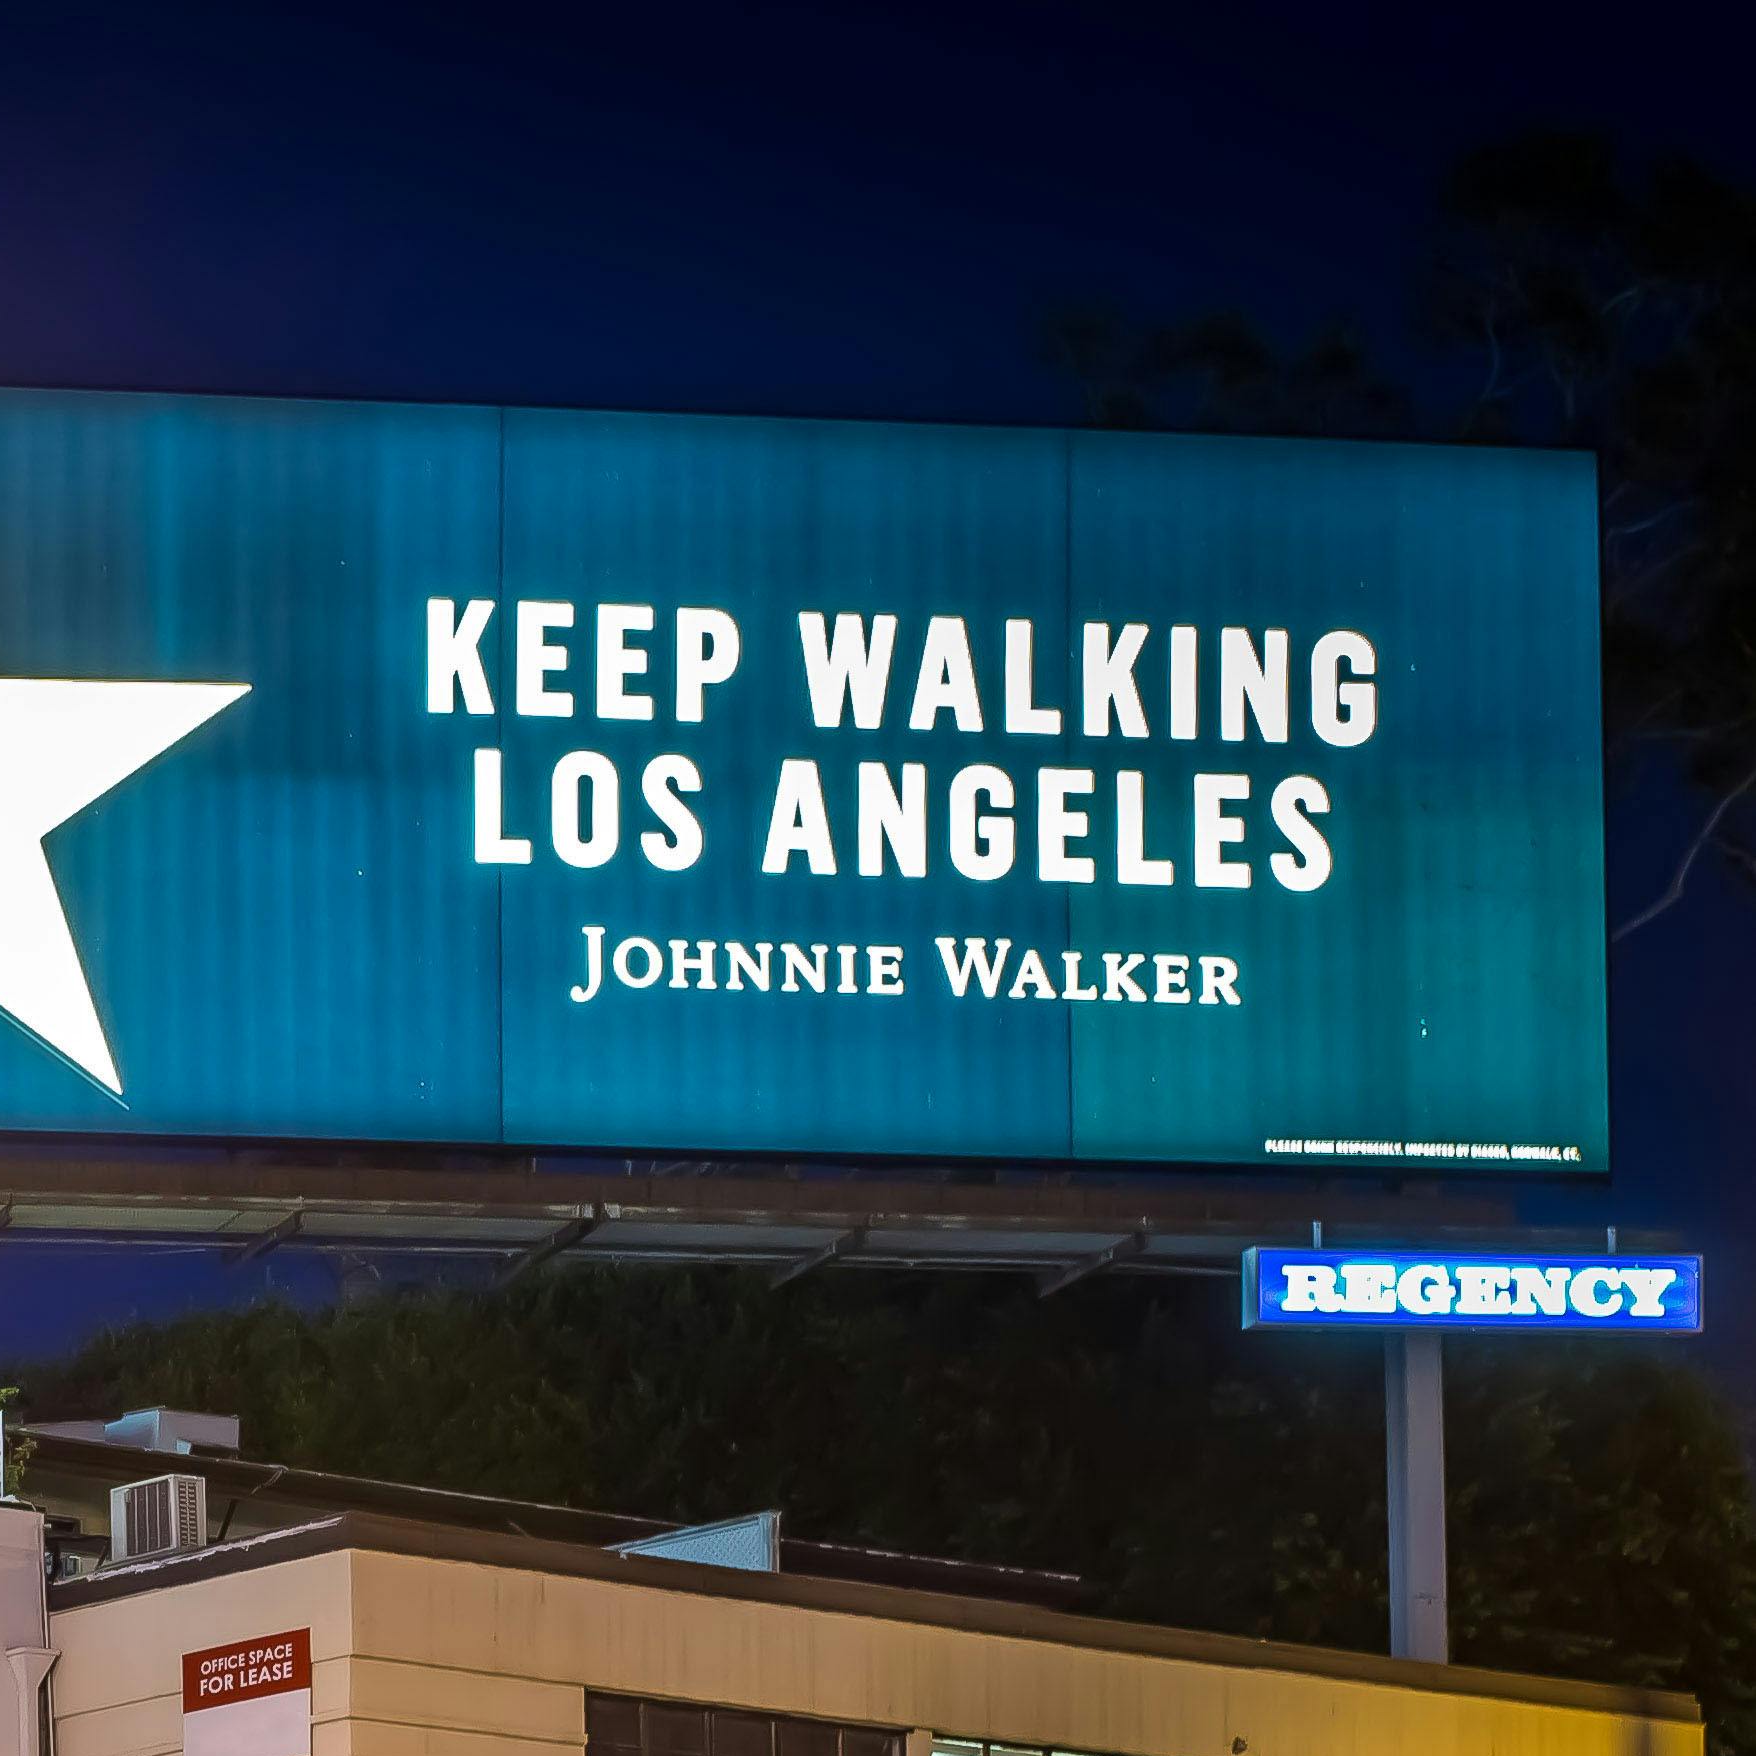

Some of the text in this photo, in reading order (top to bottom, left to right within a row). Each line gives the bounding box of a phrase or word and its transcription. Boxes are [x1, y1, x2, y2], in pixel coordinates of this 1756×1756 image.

[427, 598, 1378, 747] KEEP WALKING
[473, 749, 1332, 892] LOS ANGELES
[1280, 1262, 1677, 1318] REGENCY
[199, 1660, 294, 1697] FOR LEASE
[200, 1643, 293, 1676] OFFICE SPACE
